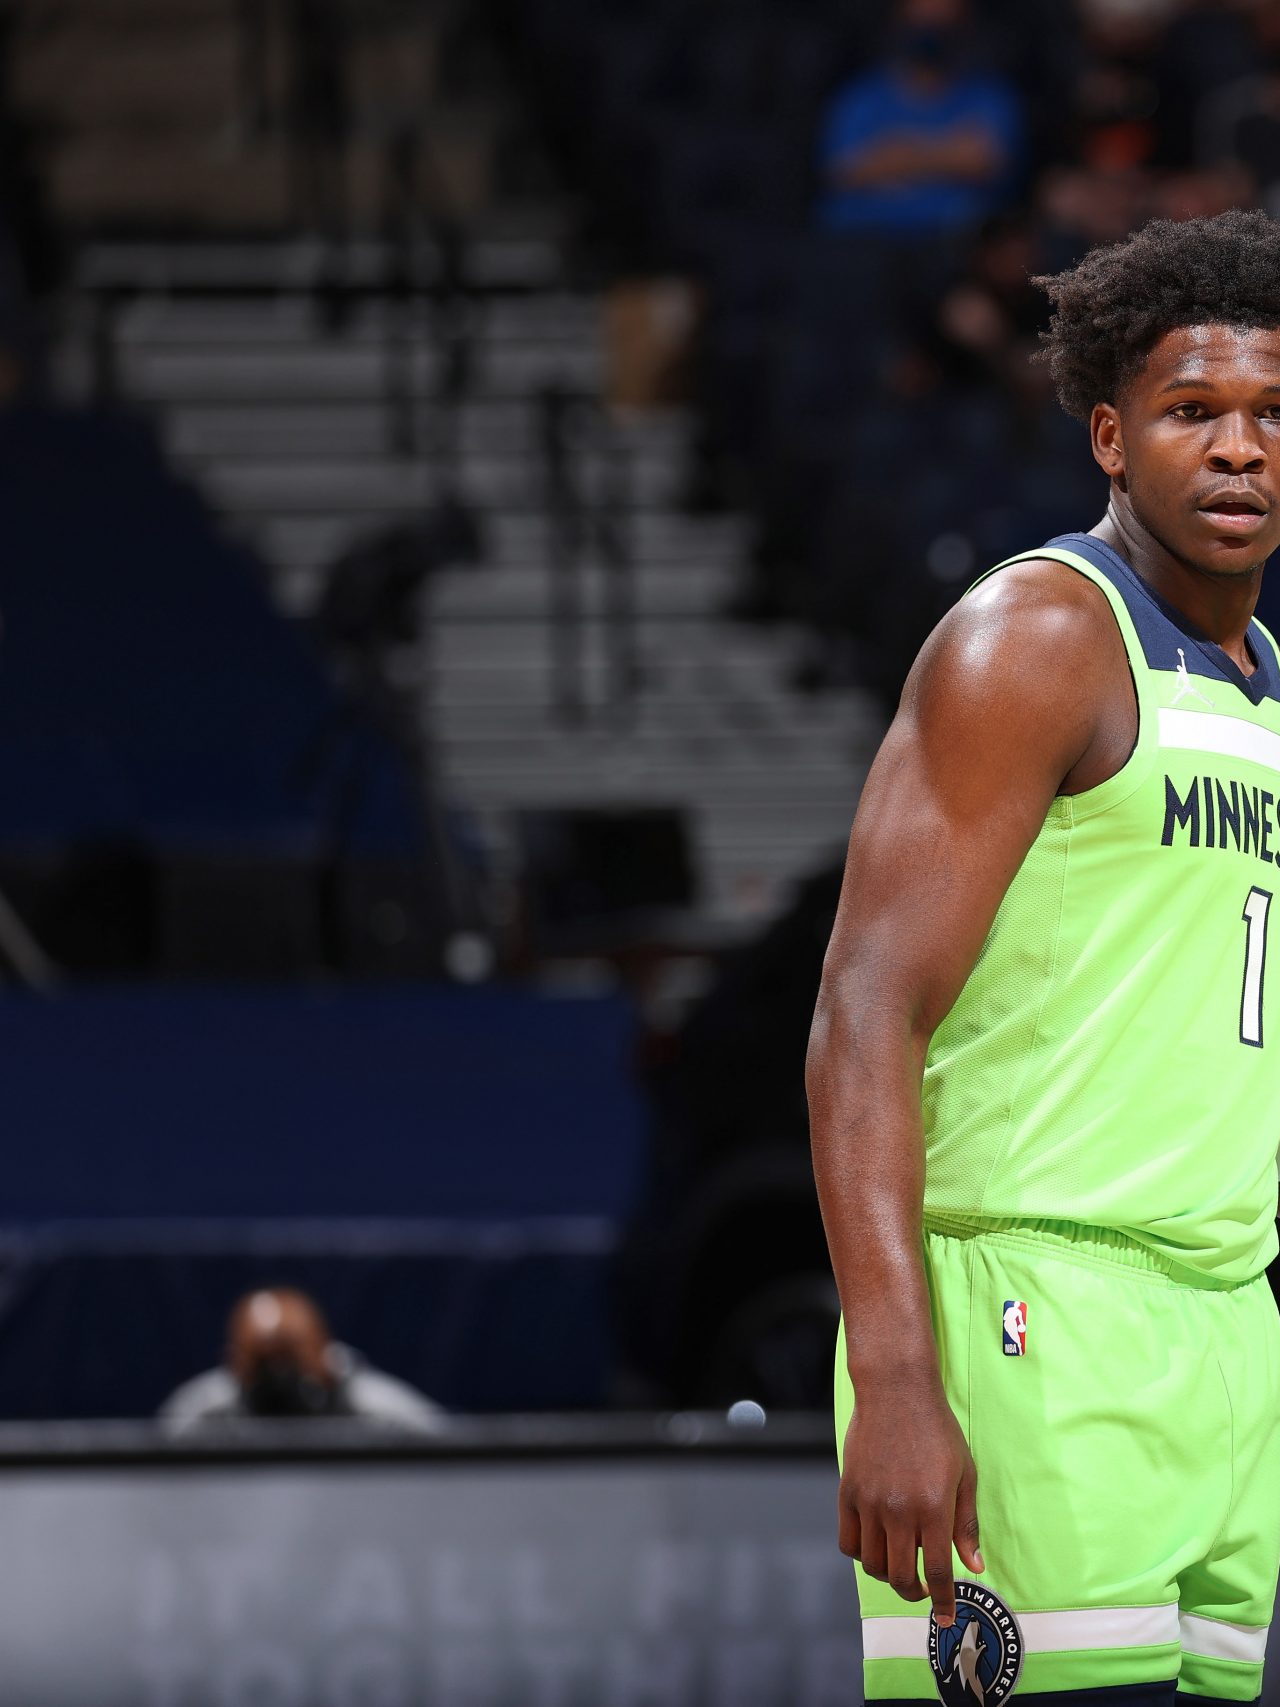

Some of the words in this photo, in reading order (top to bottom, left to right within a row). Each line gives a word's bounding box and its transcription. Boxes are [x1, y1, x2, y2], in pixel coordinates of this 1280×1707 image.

[1239, 885, 1274, 1049] 1
[1004, 1344, 1017, 1353] NBA
[958, 1585, 1018, 1697] TIMBERWOLVES
